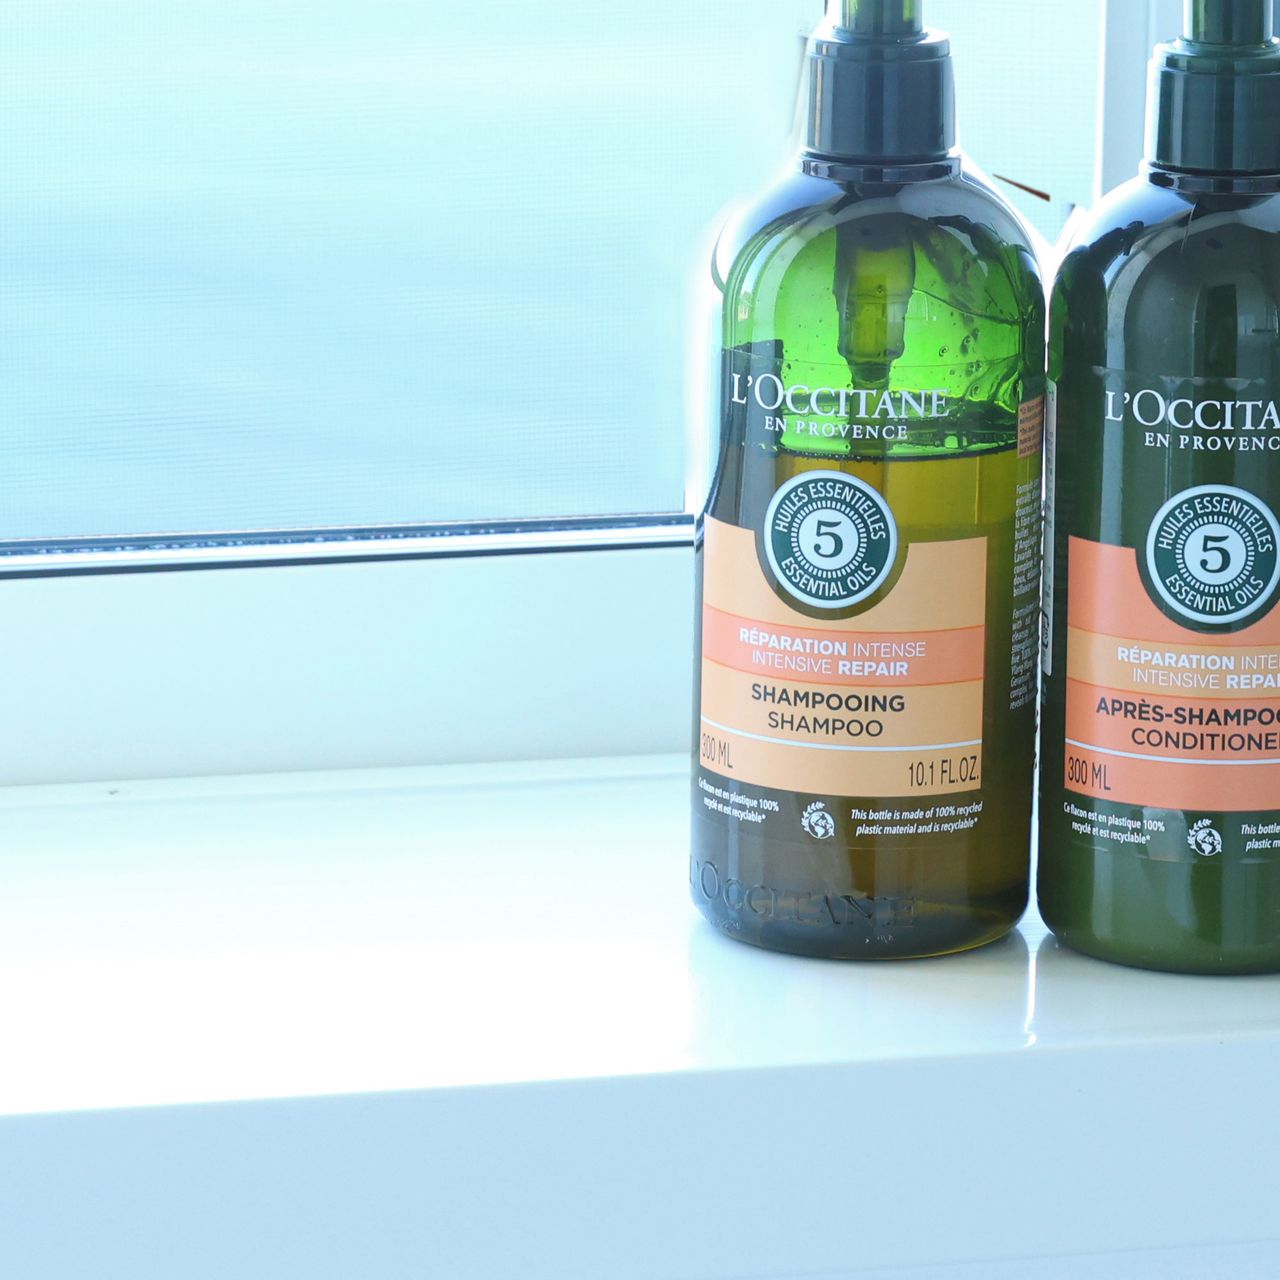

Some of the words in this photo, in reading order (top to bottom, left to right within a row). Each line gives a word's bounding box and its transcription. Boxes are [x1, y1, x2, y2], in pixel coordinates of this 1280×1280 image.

[732, 373, 949, 419] L'OCCITANE
[765, 416, 786, 432] EN
[796, 421, 908, 439] PROVENCE
[1145, 433, 1169, 447] EN
[774, 488, 808, 533] HUILES
[811, 481, 885, 540] ESSENTIELLES
[1158, 503, 1194, 549] HUILES
[1194, 496, 1272, 553] ESSENTIELLES
[814, 520, 843, 557] 5
[1200, 535, 1231, 573] 5
[782, 557, 847, 597] ESSENTIAL
[847, 562, 877, 592] OILS
[1166, 574, 1235, 611] ESSENTIAL
[1235, 577, 1264, 604] OILS
[739, 627, 847, 656] RÉPARATION
[853, 642, 926, 657] INTENSE
[752, 650, 832, 674] INTENSIVE
[838, 660, 908, 676] REPAIR
[1118, 646, 1235, 669] RÉPARATION
[1132, 668, 1219, 689] INTENSIVE
[752, 683, 905, 712] SHAMPOOING
[768, 712, 883, 737] SHAMPOO
[702, 733, 715, 760] 300
[719, 740, 733, 769] ML
[909, 761, 935, 787] 10.1
[1068, 757, 1087, 784] 300
[1092, 762, 1111, 791] ML
[723, 791, 729, 800] en
[730, 792, 757, 808] plastique
[759, 799, 779, 812] 100%
[851, 809, 867, 819] This
[868, 809, 892, 820] bottle
[894, 810, 900, 819] is
[902, 809, 923, 819] made
[925, 807, 934, 818] of
[936, 806, 955, 817] 100%
[956, 801, 983, 816] recycled
[856, 824, 882, 836] plastic
[884, 823, 917, 834] material
[918, 822, 931, 833] and
[933, 821, 939, 831] is
[1088, 812, 1097, 821] est
[1099, 814, 1107, 823] en
[1108, 815, 1141, 830] plastique
[1143, 820, 1165, 832] 100%
[1092, 827, 1099, 835] et
[1100, 829, 1109, 838] est
[1241, 824, 1256, 834] This
[1258, 823, 1280, 834] bottle
[1246, 839, 1271, 852] plastic
